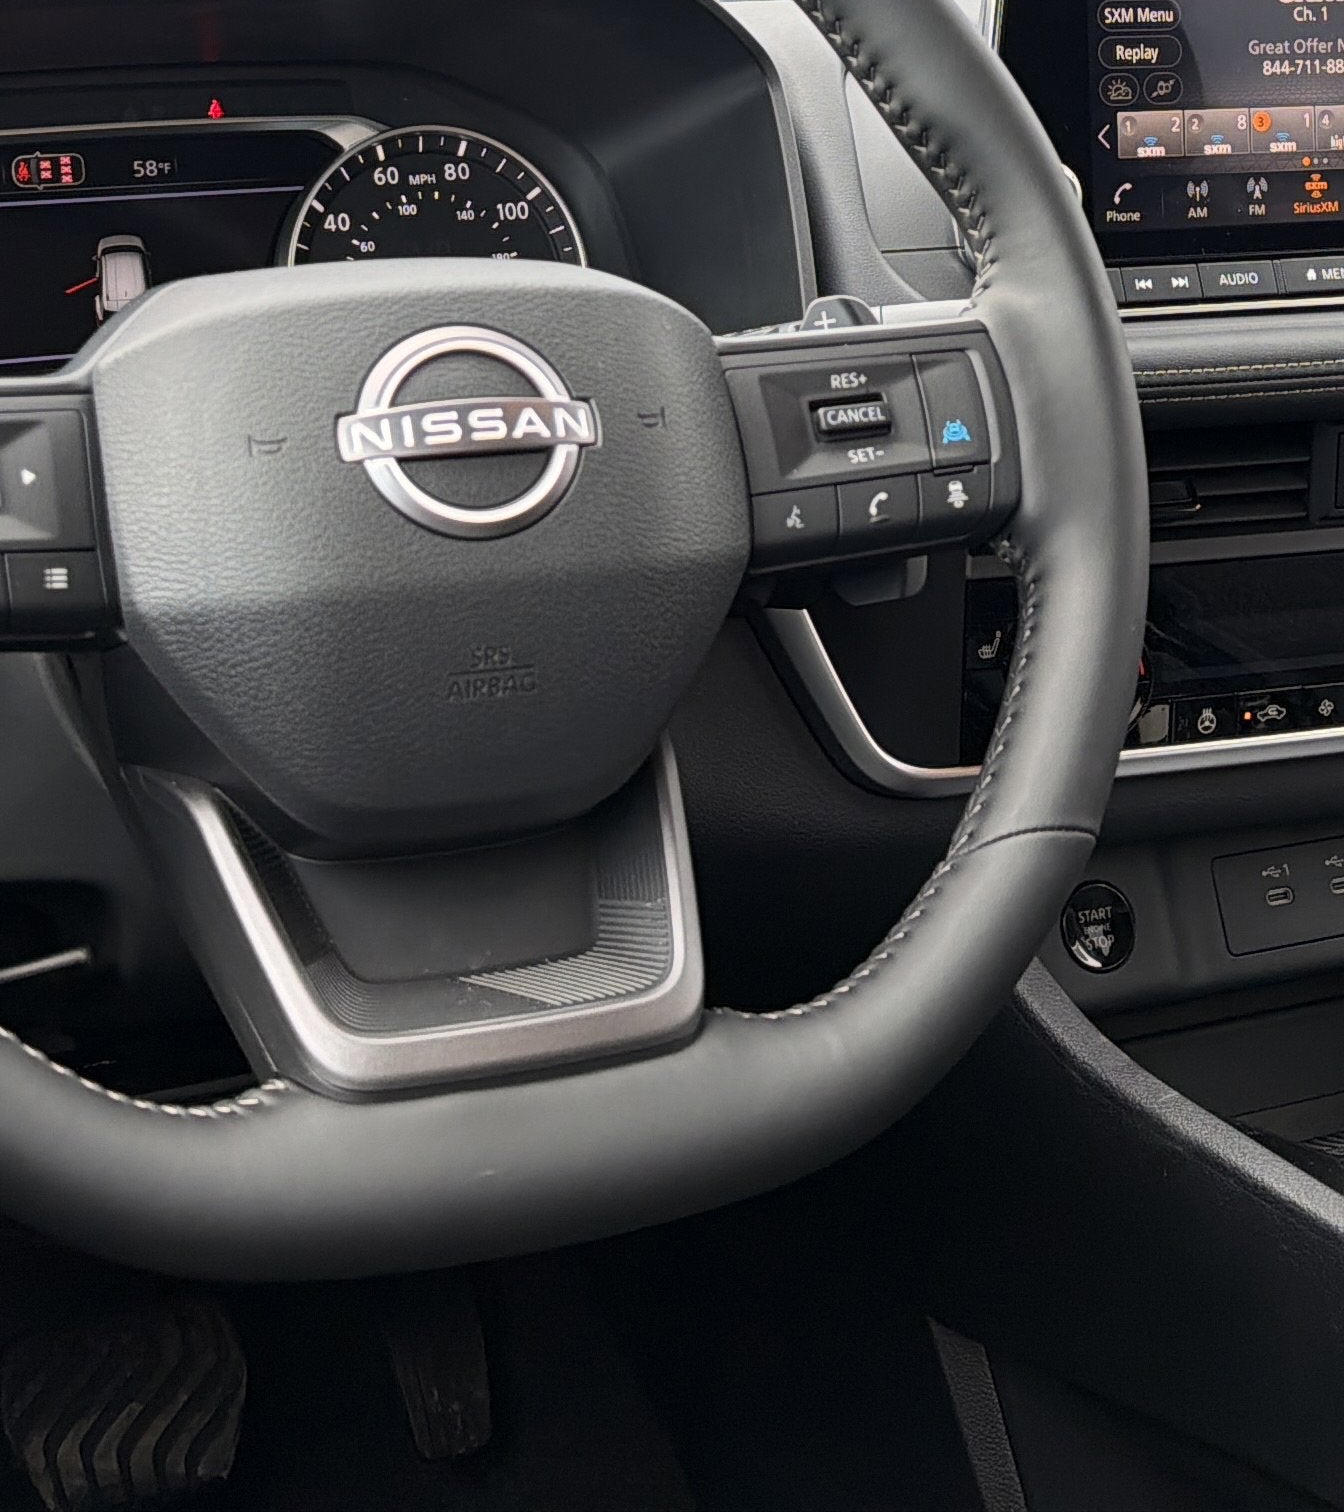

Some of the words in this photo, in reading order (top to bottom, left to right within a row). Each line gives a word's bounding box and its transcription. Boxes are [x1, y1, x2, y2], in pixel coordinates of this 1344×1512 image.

[1104, 8, 1133, 23] SXM
[1137, 7, 1174, 23] Menu
[1293, 7, 1316, 22] Ch.
[1321, 6, 1328, 21] 1
[1116, 44, 1159, 63] Replay
[1248, 39, 1291, 56] Great
[1294, 38, 1332, 55] Offer
[1124, 120, 1131, 133] 1
[1171, 116, 1181, 132] 2
[1191, 118, 1199, 130] 2
[1237, 114, 1247, 130] 8
[1257, 116, 1265, 127] 3
[1303, 113, 1310, 128] 1
[1321, 114, 1330, 125] 4
[1137, 146, 1166, 158] sxm
[1203, 144, 1232, 155] sxm
[1269, 141, 1297, 153] sxm
[373, 166, 399, 186] 60
[444, 162, 470, 181] 80
[408, 173, 436, 186] MPH
[397, 204, 418, 216] 100
[456, 209, 475, 221] 140
[496, 201, 529, 221] 100
[1187, 207, 1208, 218] AM
[1249, 205, 1266, 216] FM
[1293, 201, 1340, 214] SiriusXM
[323, 213, 350, 232] 40
[1106, 210, 1141, 223] Phone
[360, 241, 375, 253] 60
[1219, 272, 1259, 286] AUDIO
[830, 372, 868, 389] RES+
[826, 406, 886, 425] CANCEL
[350, 407, 590, 453] NISSAN
[847, 446, 885, 463] SET-
[470, 644, 513, 668] SRS
[447, 675, 537, 701] AIRBAG
[1283, 863, 1290, 876] 1
[1078, 906, 1112, 924] START
[1085, 934, 1115, 951] STOP
